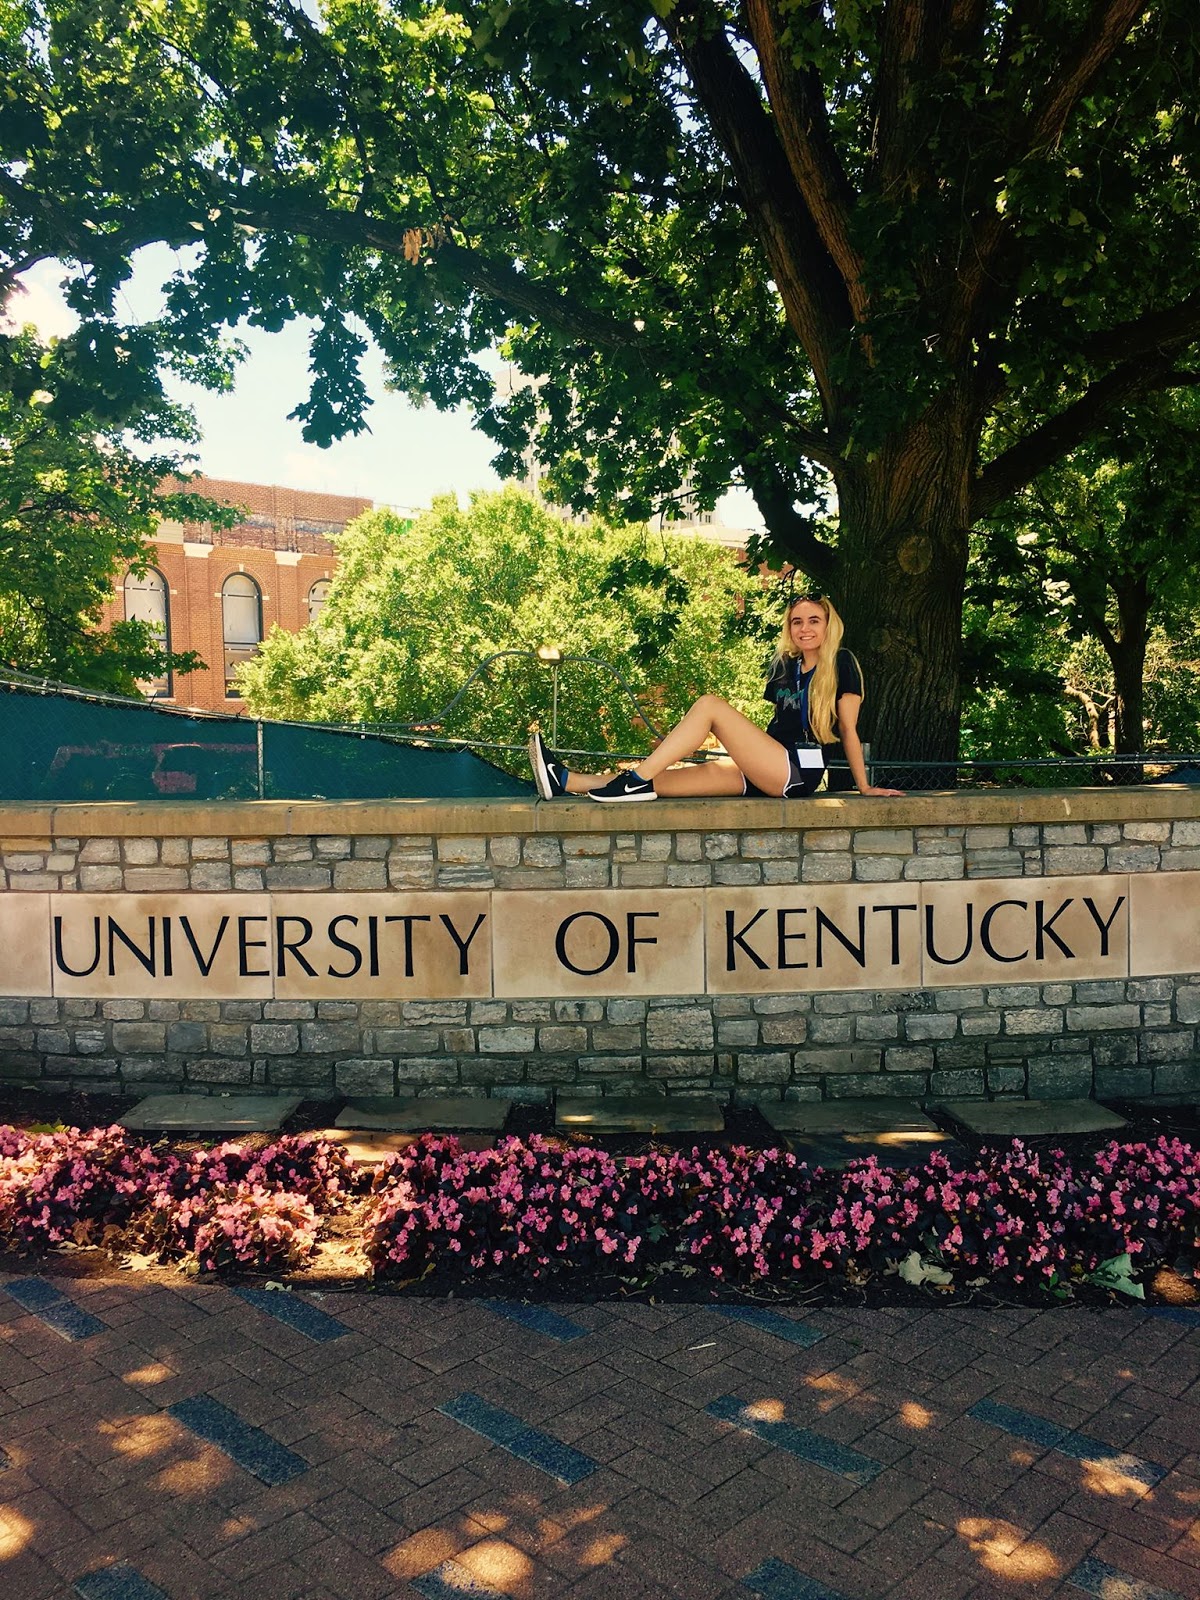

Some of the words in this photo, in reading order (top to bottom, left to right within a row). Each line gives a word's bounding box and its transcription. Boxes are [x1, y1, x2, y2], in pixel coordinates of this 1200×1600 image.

[54, 914, 487, 978] UNIVERSITY
[555, 911, 660, 976] OF
[725, 896, 1126, 972] KENTUCKY
